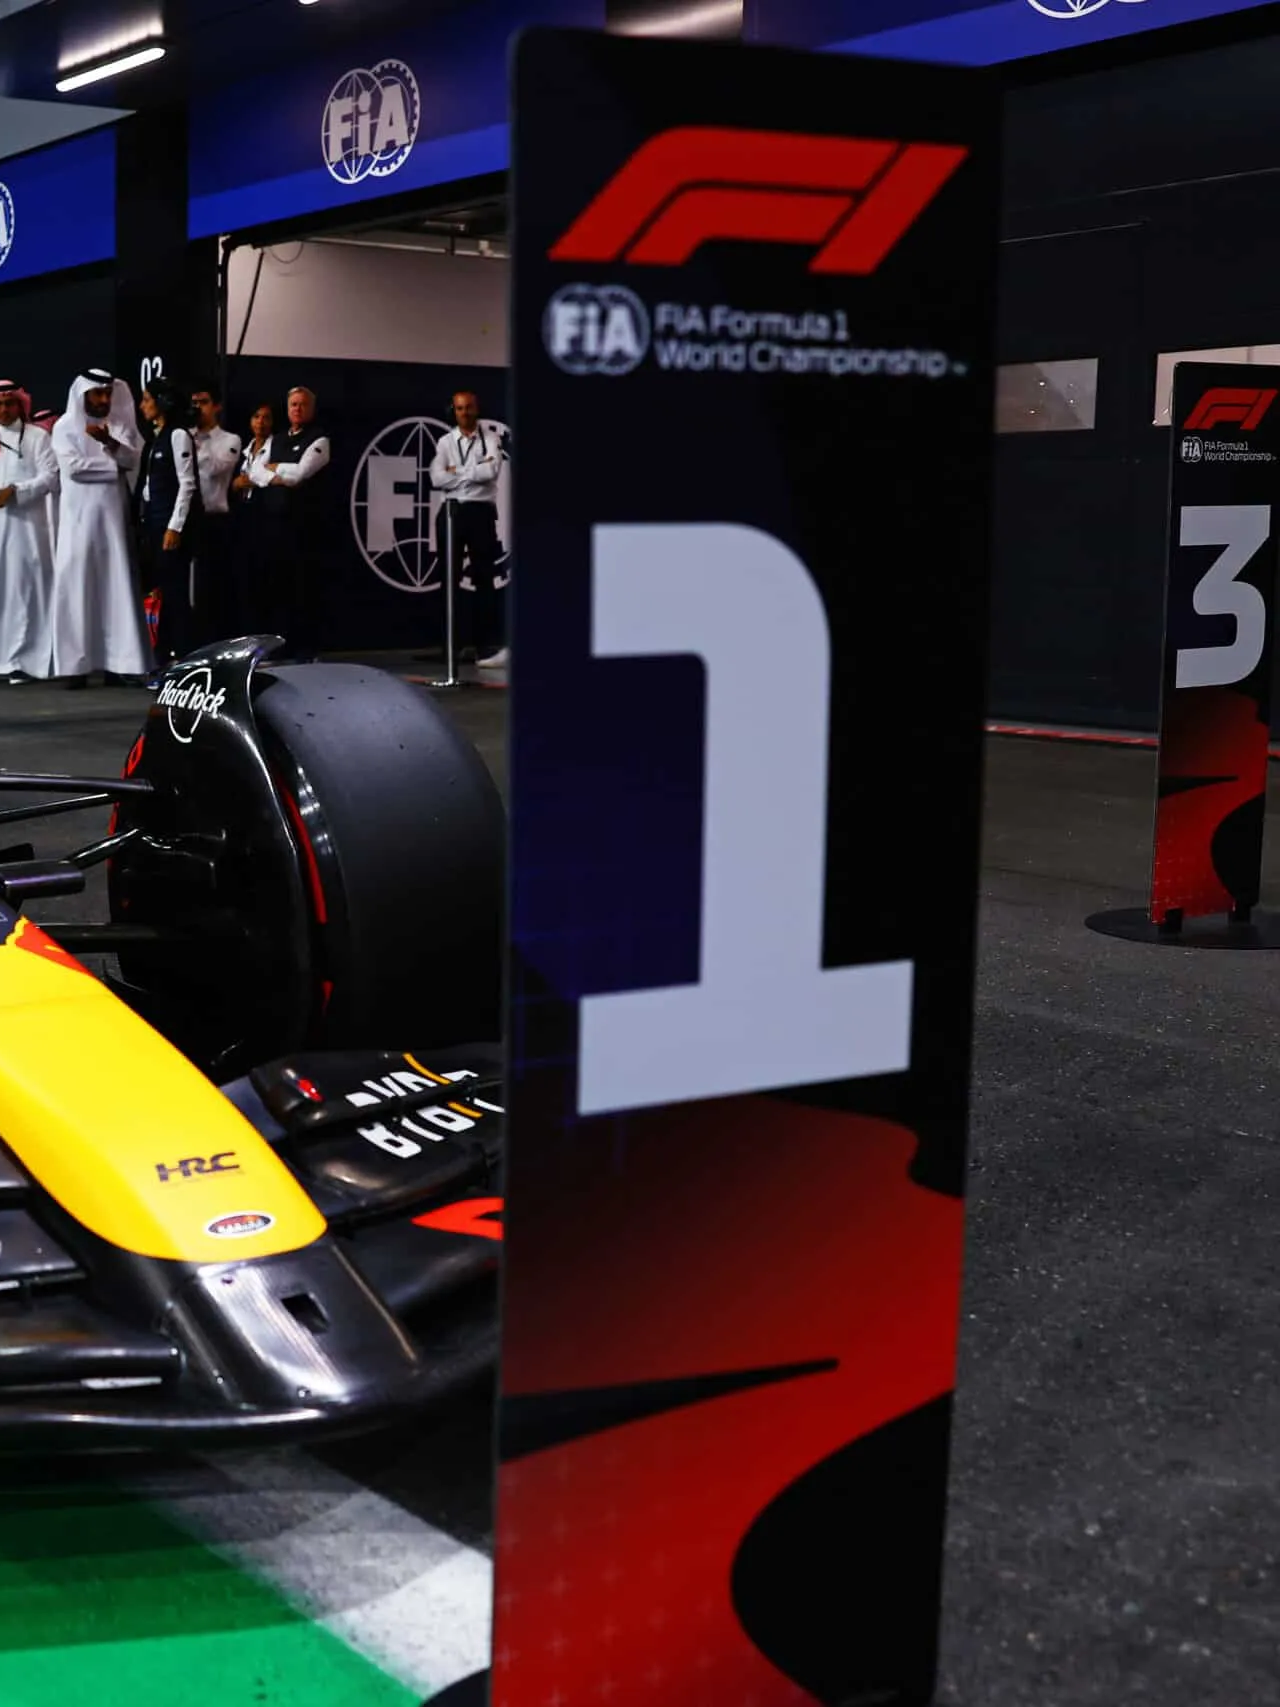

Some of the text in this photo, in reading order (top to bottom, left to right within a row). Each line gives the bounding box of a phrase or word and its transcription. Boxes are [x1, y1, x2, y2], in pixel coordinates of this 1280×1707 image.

[654, 303, 849, 341] FIA Formula 1
[654, 339, 948, 377] World Championship
[1204, 441, 1217, 451] FIA
[1217, 441, 1243, 451] Formula
[1204, 451, 1272, 462] World Championship
[1174, 505, 1271, 688] 3
[578, 522, 914, 1116] 1
[155, 1151, 241, 1183] HRC
